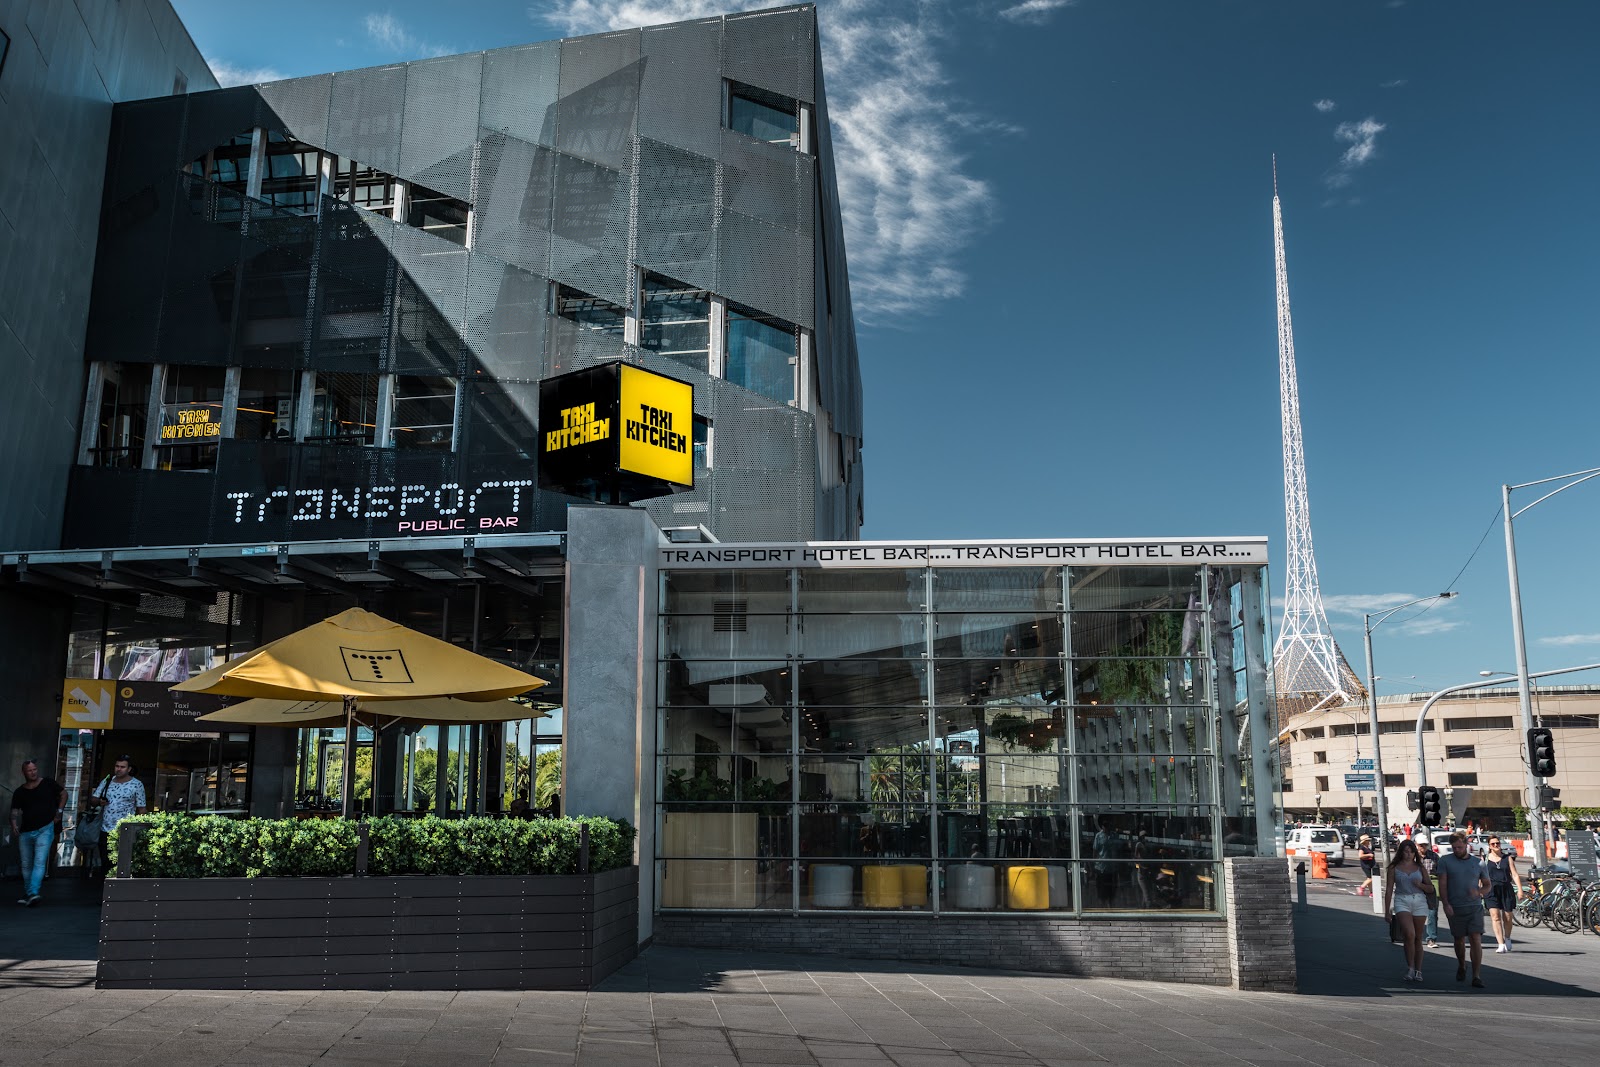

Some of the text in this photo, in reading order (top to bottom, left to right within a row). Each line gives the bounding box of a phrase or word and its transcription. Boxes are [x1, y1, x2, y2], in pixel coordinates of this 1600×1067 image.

[178, 409, 210, 424] TAXI
[560, 402, 596, 429] TAXI
[640, 403, 673, 431] TAXI
[162, 422, 221, 439] KITCHEN
[546, 418, 610, 453] KITCHEN
[626, 418, 687, 454] KITCHEN
[398, 516, 519, 532] PUBLIC BAR
[662, 550, 796, 563] TRANSPORT
[803, 549, 876, 562] HOTEL
[952, 546, 1091, 559] TRANSPORT
[1098, 545, 1173, 558] HOTEL
[68, 698, 89, 707] Entry
[123, 700, 160, 709] Transport
[173, 709, 201, 717] Kitchen
